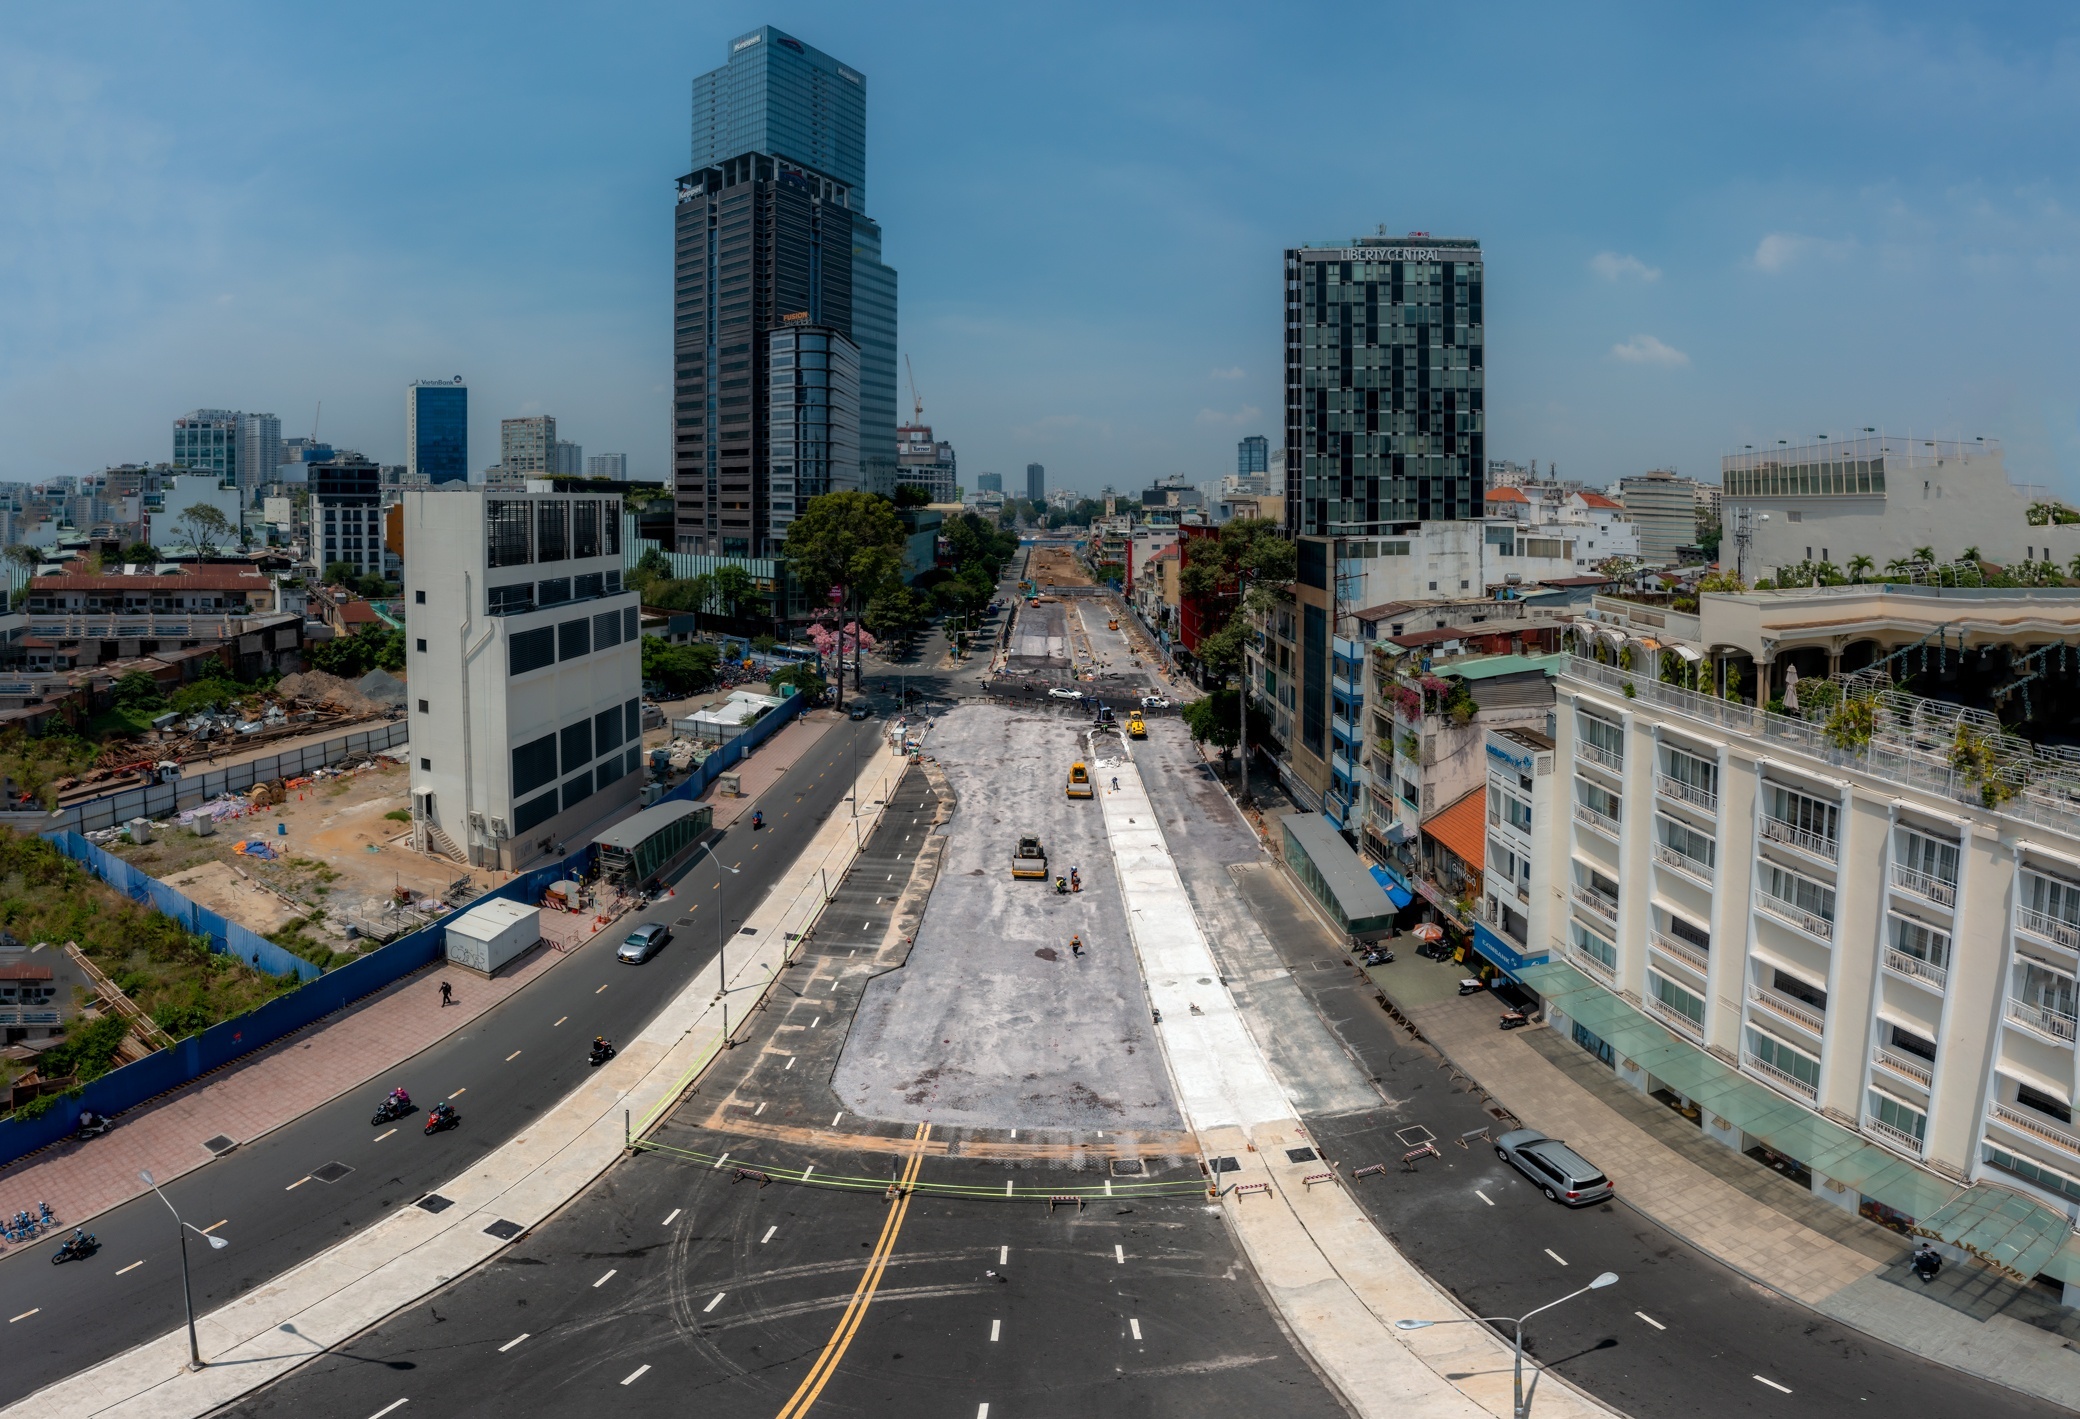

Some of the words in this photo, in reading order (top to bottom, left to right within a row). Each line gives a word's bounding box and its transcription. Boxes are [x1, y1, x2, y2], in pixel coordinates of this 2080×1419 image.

[1340, 249, 1386, 261] LIBERTY
[1387, 249, 1441, 261] CENTRAL
[783, 311, 808, 321] FUSION
[1451, 863, 1477, 887] GINKGO
[1906, 1223, 1945, 1243] REX
[1951, 1239, 2027, 1282] ARCADE
